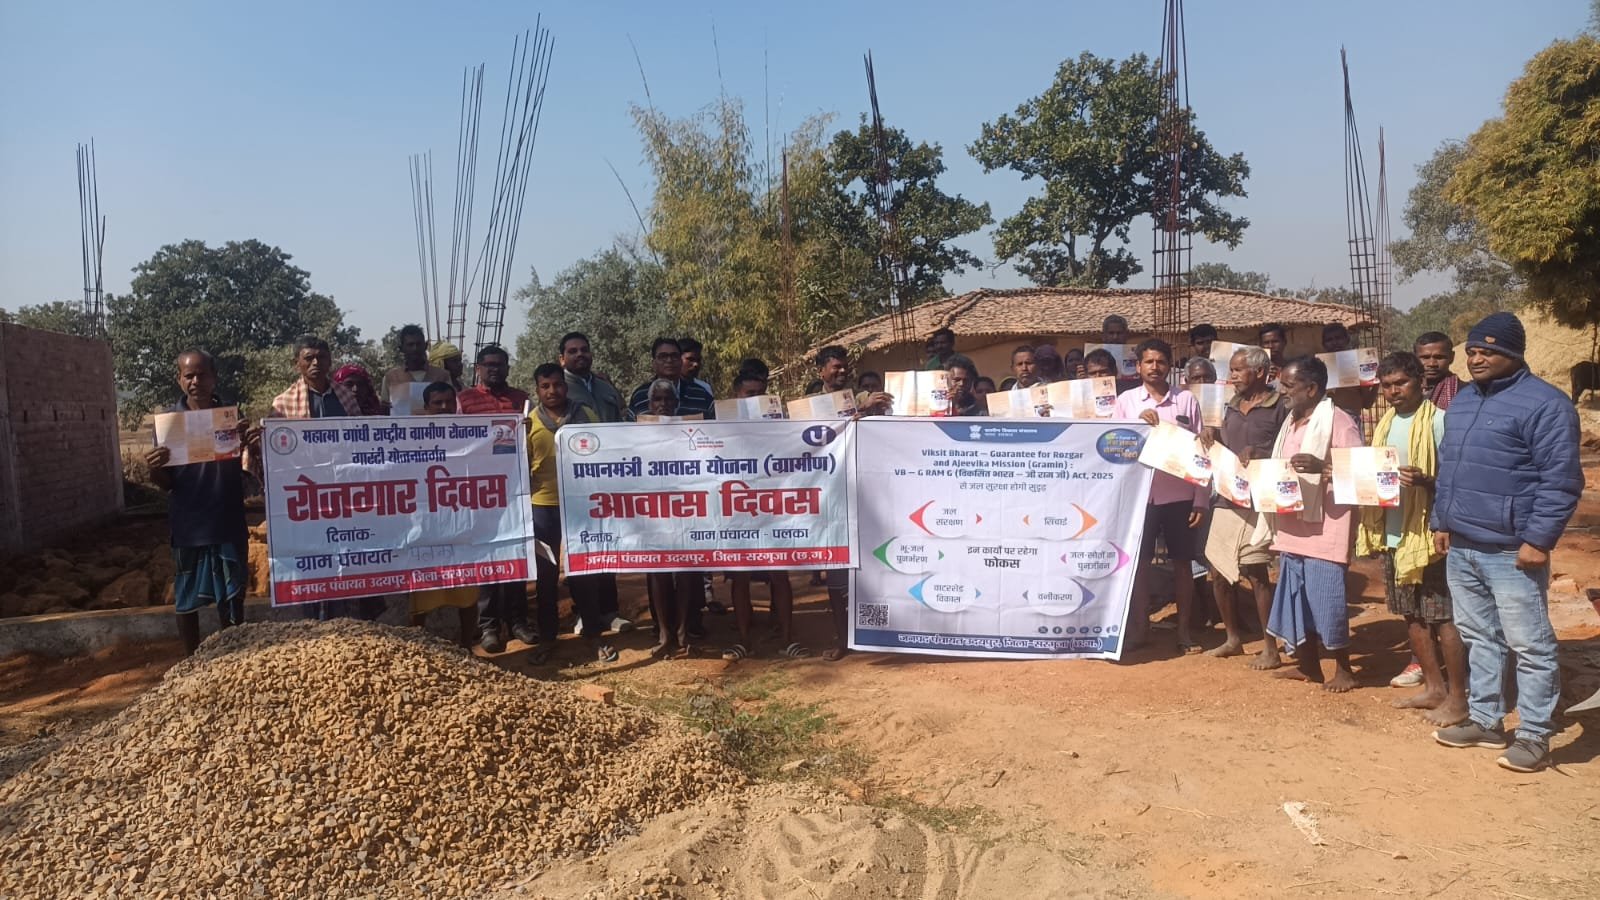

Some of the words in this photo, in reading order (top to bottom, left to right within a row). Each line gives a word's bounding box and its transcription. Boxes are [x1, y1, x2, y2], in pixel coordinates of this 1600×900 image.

[303, 428, 339, 443] महात्मा
[343, 424, 369, 442] गांधी
[374, 423, 406, 443] राष्ट्रीय
[410, 425, 445, 441] ग्रामीण
[450, 423, 488, 439] रोजगार
[352, 448, 385, 466] गारंटी
[388, 448, 446, 464] योजनांतर्गत
[922, 449, 946, 457] Viksit
[949, 449, 978, 457] Bharat
[990, 450, 1035, 458] Guarantee
[1053, 451, 1083, 460] Rozgar
[573, 456, 642, 478] प्रधानमंत्री
[648, 460, 700, 476] आवास
[707, 456, 758, 475] योजना
[764, 453, 836, 476] (ग्रामीण)
[933, 459, 949, 467] and
[952, 459, 989, 468] Ajeevika
[992, 460, 1025, 468] Mission
[1028, 460, 1068, 469] (Gramin)
[1073, 472, 1089, 480] Act,
[284, 474, 418, 522] रोजगार
[425, 465, 508, 513] दिवस
[589, 490, 709, 518] आवास
[719, 480, 822, 517] दिवस
[690, 530, 716, 541] ग्राम
[720, 528, 759, 540] पंचायत
[772, 528, 808, 539] पलका
[586, 553, 618, 565] जनपद
[622, 552, 660, 564] पंचायत
[713, 550, 787, 564] जिला-सरगुजा
[791, 548, 832, 561] (छ.ग.)
[967, 546, 980, 555] इन
[1004, 547, 1018, 555] पर
[1020, 546, 1038, 556] रहेगा
[296, 553, 332, 572] ग्राम
[984, 558, 1020, 569] फोकस
[292, 581, 327, 595] जनपद
[329, 578, 366, 593] पंचायत
